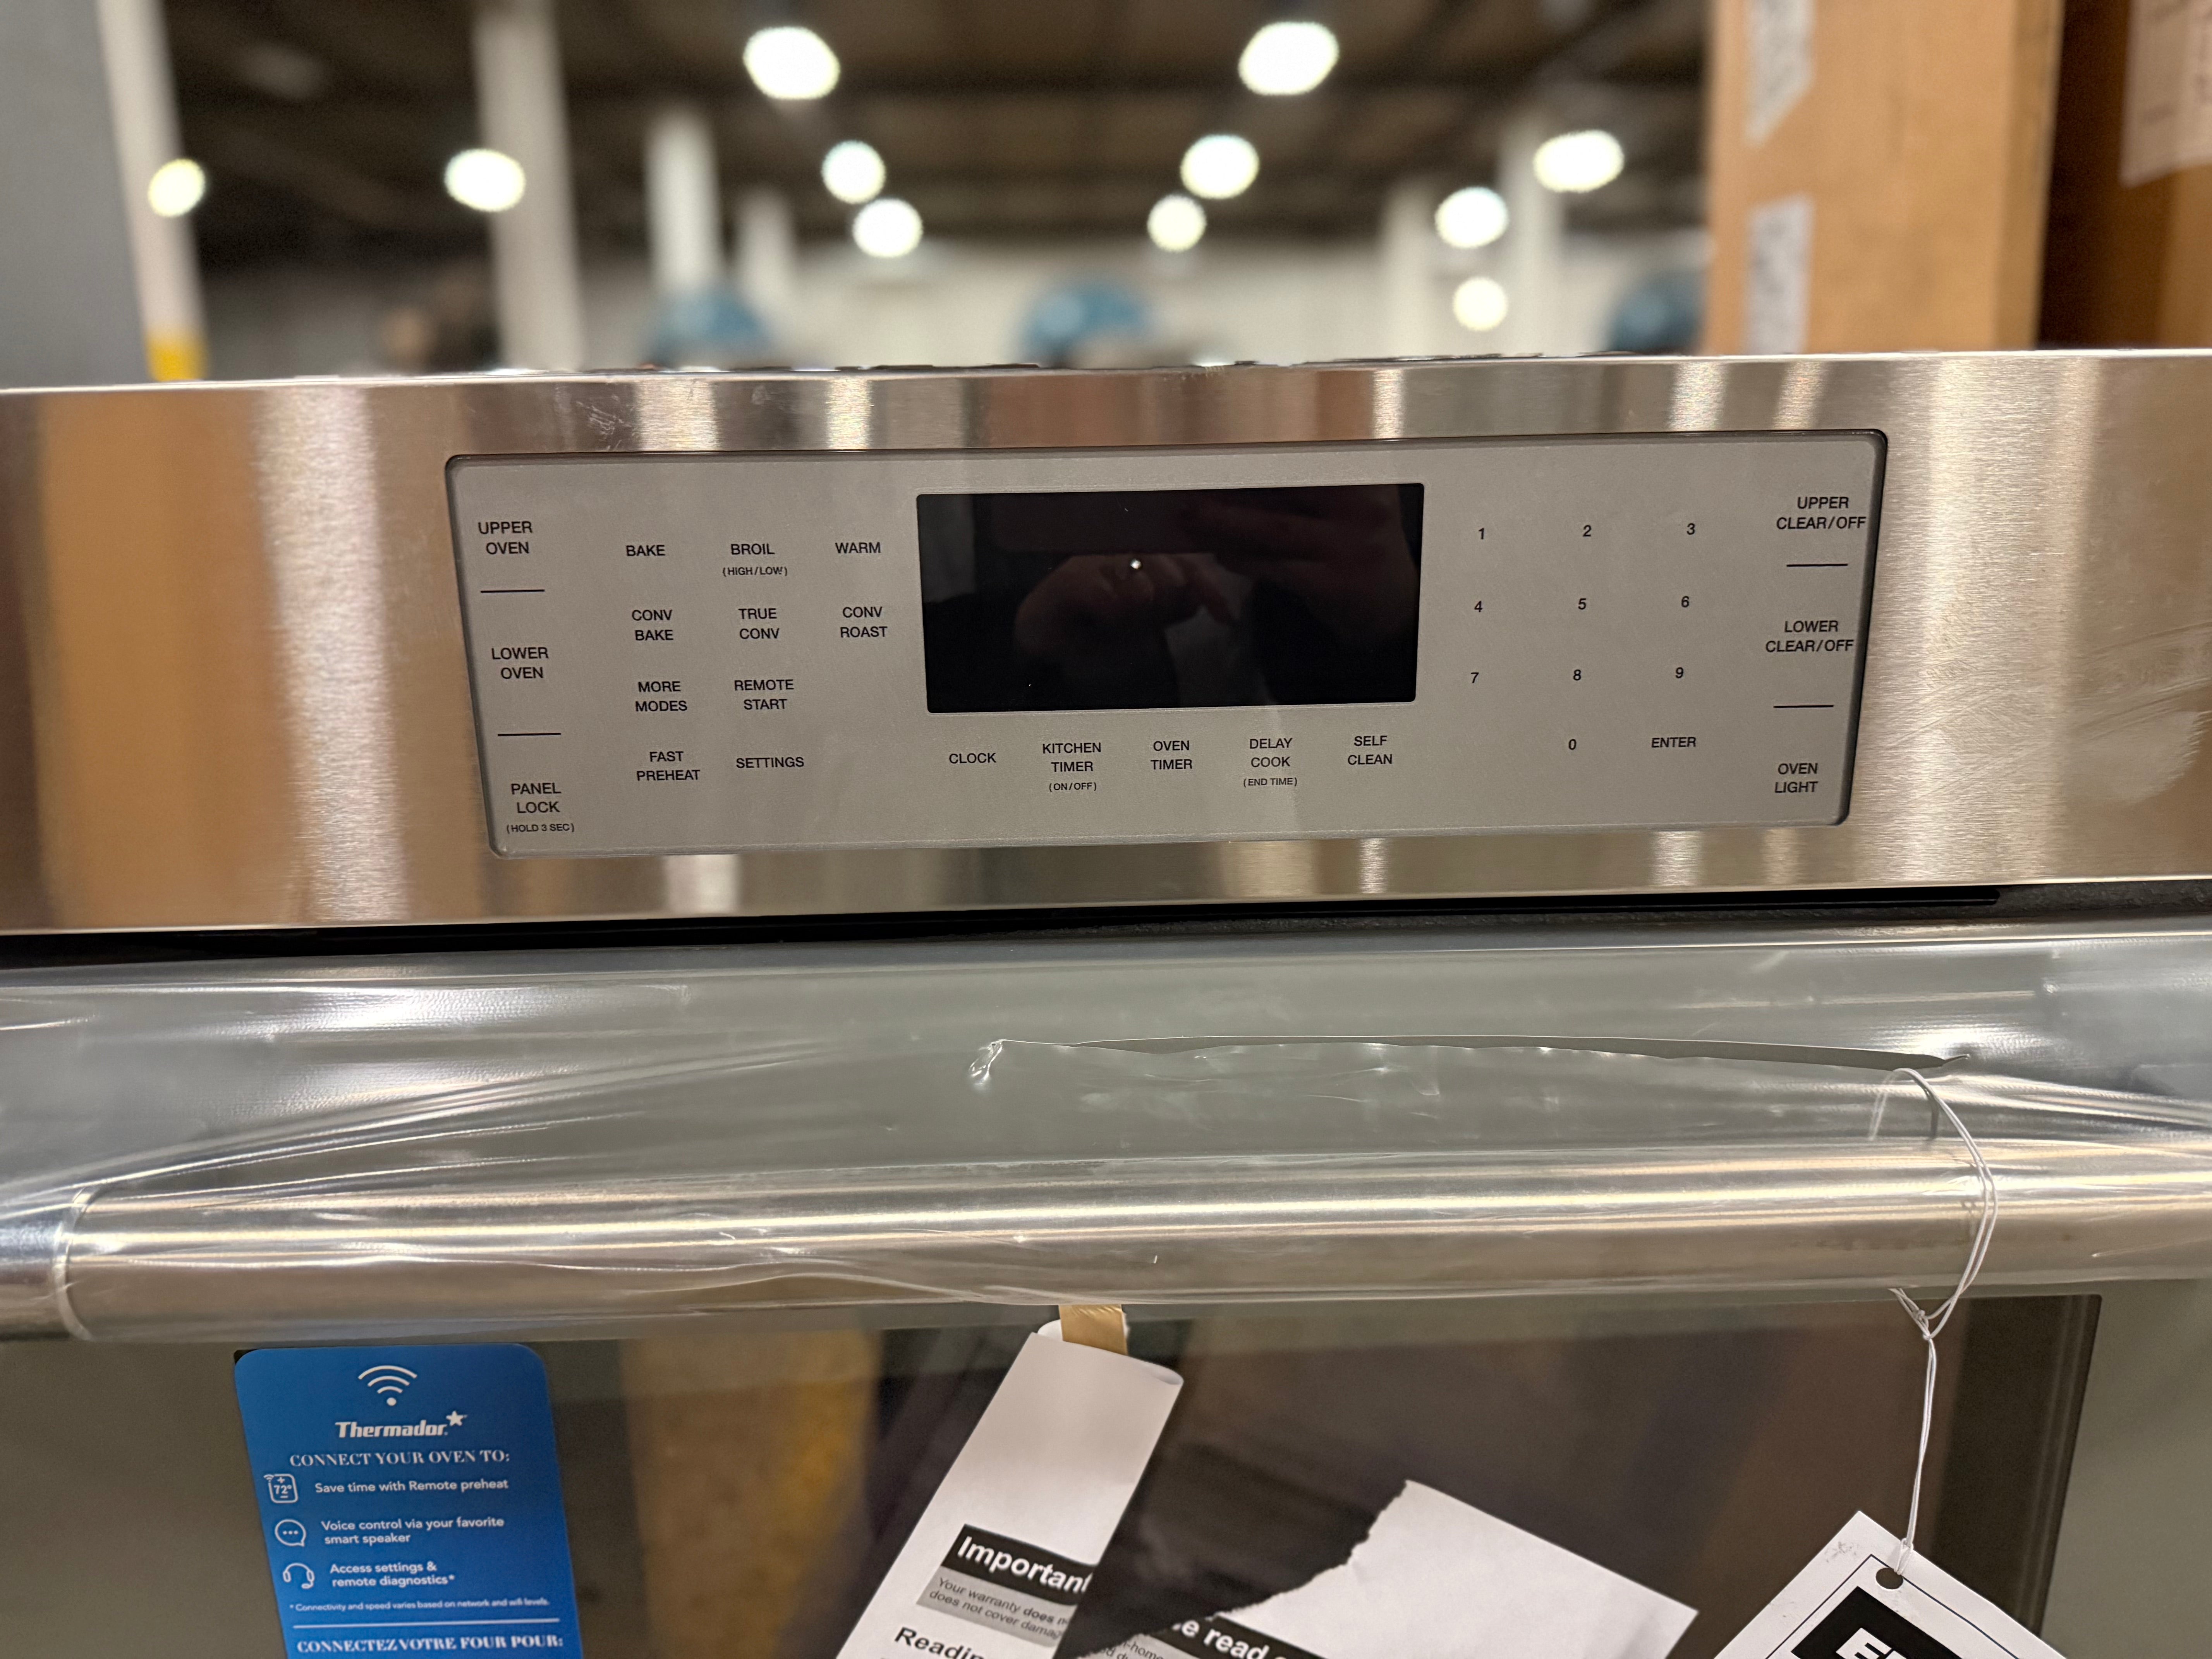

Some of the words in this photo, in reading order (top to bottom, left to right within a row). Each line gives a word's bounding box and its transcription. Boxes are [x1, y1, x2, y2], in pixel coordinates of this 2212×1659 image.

[1797, 496, 1849, 509] UPPER
[478, 521, 533, 534] UPPER
[1686, 523, 1695, 535] 3
[1776, 516, 1866, 530] CLEAR/OFF
[1479, 527, 1484, 540] 1
[1583, 525, 1592, 537] 2
[486, 541, 529, 555] OVEN
[626, 544, 666, 556] BAKE
[731, 543, 775, 555] BROIL
[835, 542, 881, 554] WARM
[722, 566, 787, 577] (HIGH/LOW)
[1474, 601, 1483, 613] 4
[1578, 598, 1586, 610] 5
[1681, 596, 1690, 608] 6
[632, 609, 672, 621] CONV
[738, 608, 777, 620] TRUE
[842, 606, 883, 618] CONV
[840, 626, 888, 638] ROAST
[1784, 620, 1839, 633] LOWER
[635, 629, 674, 641] BAKE
[739, 628, 780, 639] CONV
[1765, 639, 1854, 653] CLEAR/OFF
[491, 647, 549, 660] LOWER
[501, 667, 543, 679] OVEN
[1470, 672, 1479, 684] 7
[1573, 669, 1582, 681] 8
[1675, 667, 1684, 678] 9
[638, 681, 681, 692] MORE
[734, 679, 794, 691] REMOTE
[635, 700, 688, 712] MODES
[744, 699, 787, 710] START
[1153, 740, 1190, 751] OVEN
[1250, 737, 1293, 749] DELAY
[1354, 735, 1388, 747] SELF
[1568, 739, 1577, 750] 0
[1651, 737, 1696, 748] ENTER
[1042, 742, 1101, 754] KITCHEN
[649, 751, 684, 762] FAST
[736, 756, 804, 769] SETTINGS
[949, 752, 996, 764] CLOCK
[1251, 756, 1290, 768] COOK
[1348, 754, 1392, 765] CLEAN
[1051, 761, 1093, 772] TIMER
[1150, 759, 1192, 770] TIMER
[1778, 763, 1818, 775] OVEN
[637, 769, 701, 781] PREHEAT
[511, 782, 562, 795] PANEL
[1049, 782, 1097, 792] (ON/OFF)
[1243, 778, 1267, 788] (END
[1269, 777, 1297, 787] TIME)
[1775, 781, 1819, 793] LIGHT
[517, 801, 560, 814] LOCK
[507, 824, 539, 834] (HOLD
[549, 823, 574, 832] SEC)
[289, 1453, 371, 1467] CONNECT
[375, 1451, 424, 1465] YOUR
[428, 1451, 476, 1463] OVEN
[479, 1449, 510, 1462] TO:
[315, 1483, 344, 1493] Save
[348, 1482, 376, 1492] time
[379, 1480, 406, 1491] with
[409, 1480, 457, 1491] Remote
[461, 1478, 509, 1493] preheat
[321, 1520, 355, 1530] Voice
[359, 1519, 402, 1530] control
[405, 1519, 422, 1528] via
[426, 1520, 453, 1531] your
[456, 1516, 505, 1528] favorite
[325, 1534, 359, 1544] smart
[362, 1533, 411, 1546] speaker
[330, 1563, 372, 1573] Access
[375, 1562, 424, 1575] settings
[426, 1561, 437, 1571] &
[332, 1577, 376, 1587] remote
[295, 1602, 346, 1611] Connectivity
[348, 1602, 364, 1610] and
[365, 1601, 391, 1611] speed
[392, 1601, 416, 1609] varies
[417, 1600, 442, 1608] based
[939, 1578, 967, 1595] Your
[969, 1590, 1021, 1614] warranty
[1023, 1607, 1054, 1623] does
[930, 1589, 960, 1606] does
[962, 1601, 983, 1614] not
[985, 1609, 1019, 1625] cover
[1020, 1621, 1064, 1640] damag
[297, 1639, 399, 1653] CONNECTEZ
[398, 1638, 456, 1652] VOTRE
[460, 1637, 507, 1650] FOUR
[511, 1635, 563, 1648] POUR:
[1203, 1628, 1271, 1659] read
